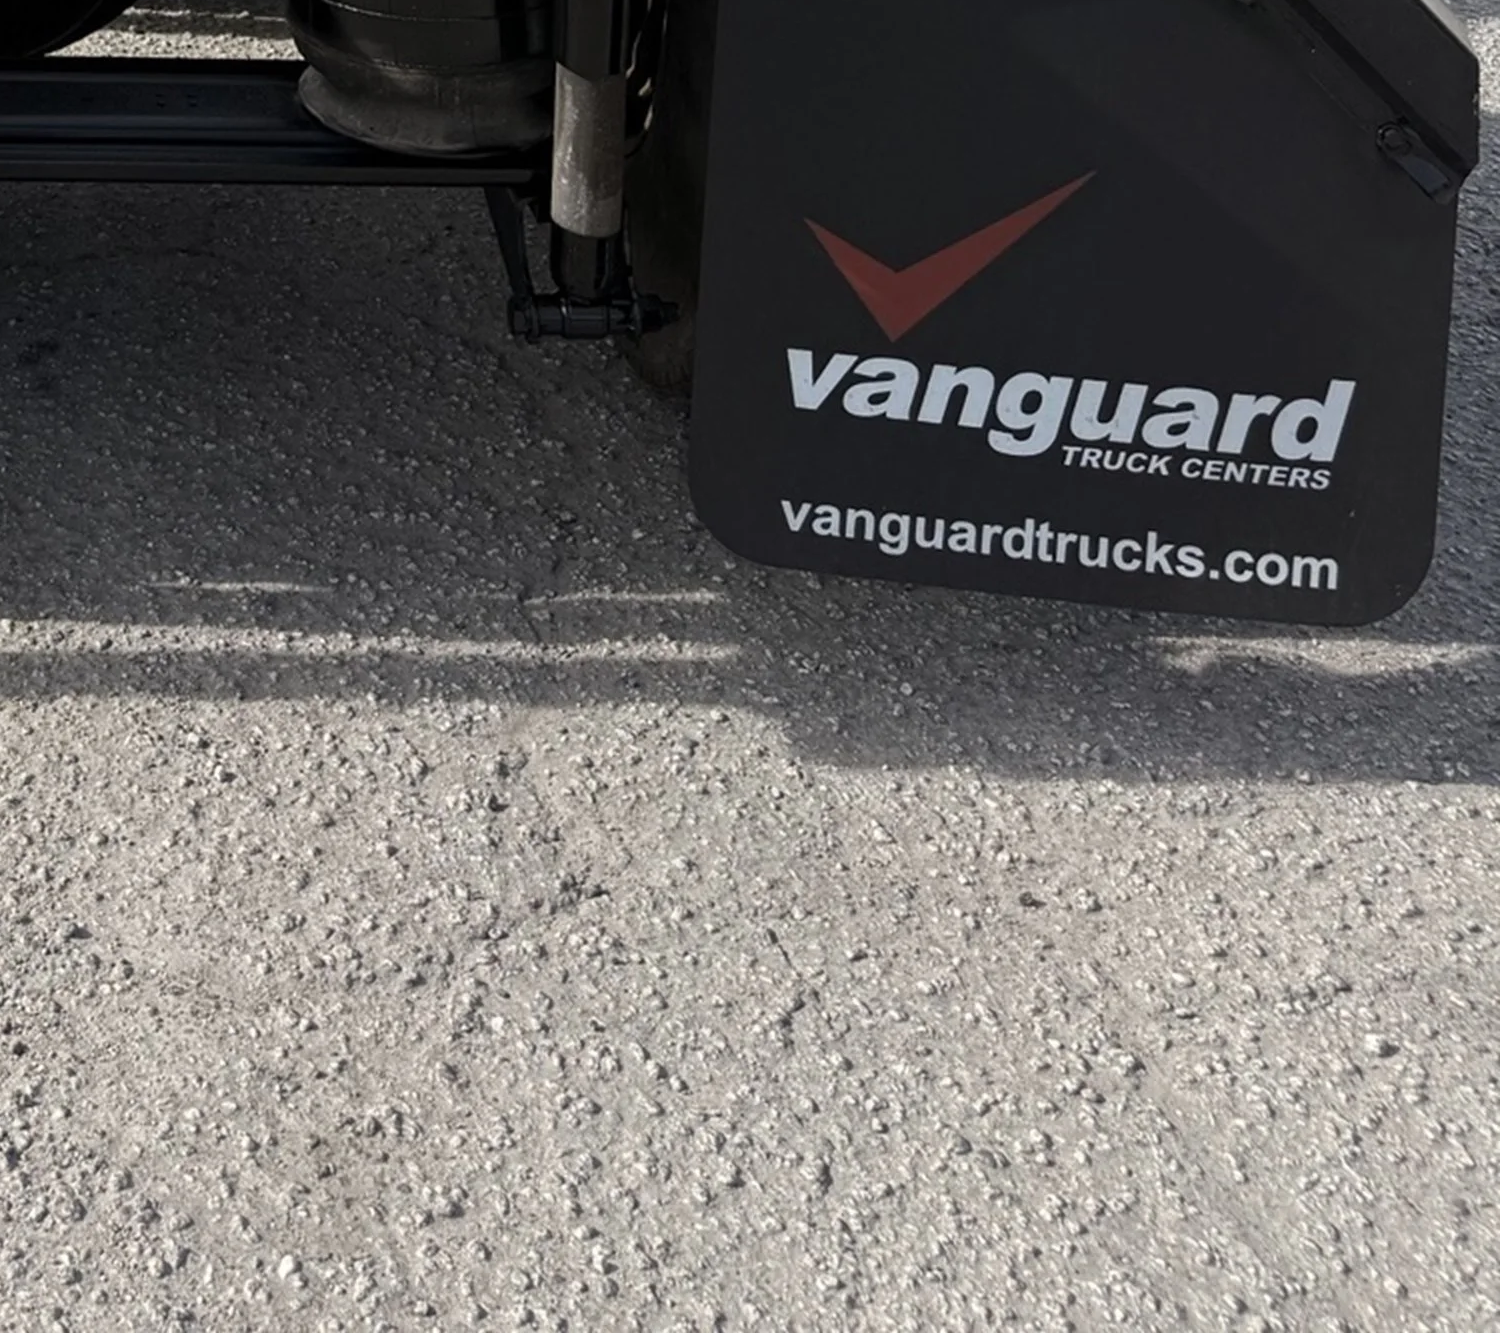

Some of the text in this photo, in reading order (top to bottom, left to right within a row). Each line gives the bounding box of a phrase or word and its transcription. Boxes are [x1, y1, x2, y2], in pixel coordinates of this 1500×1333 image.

[786, 348, 1357, 462] vanguard
[1061, 445, 1331, 490] TRUCK CENTERS
[780, 499, 1339, 590] vanguardtrucks.com
